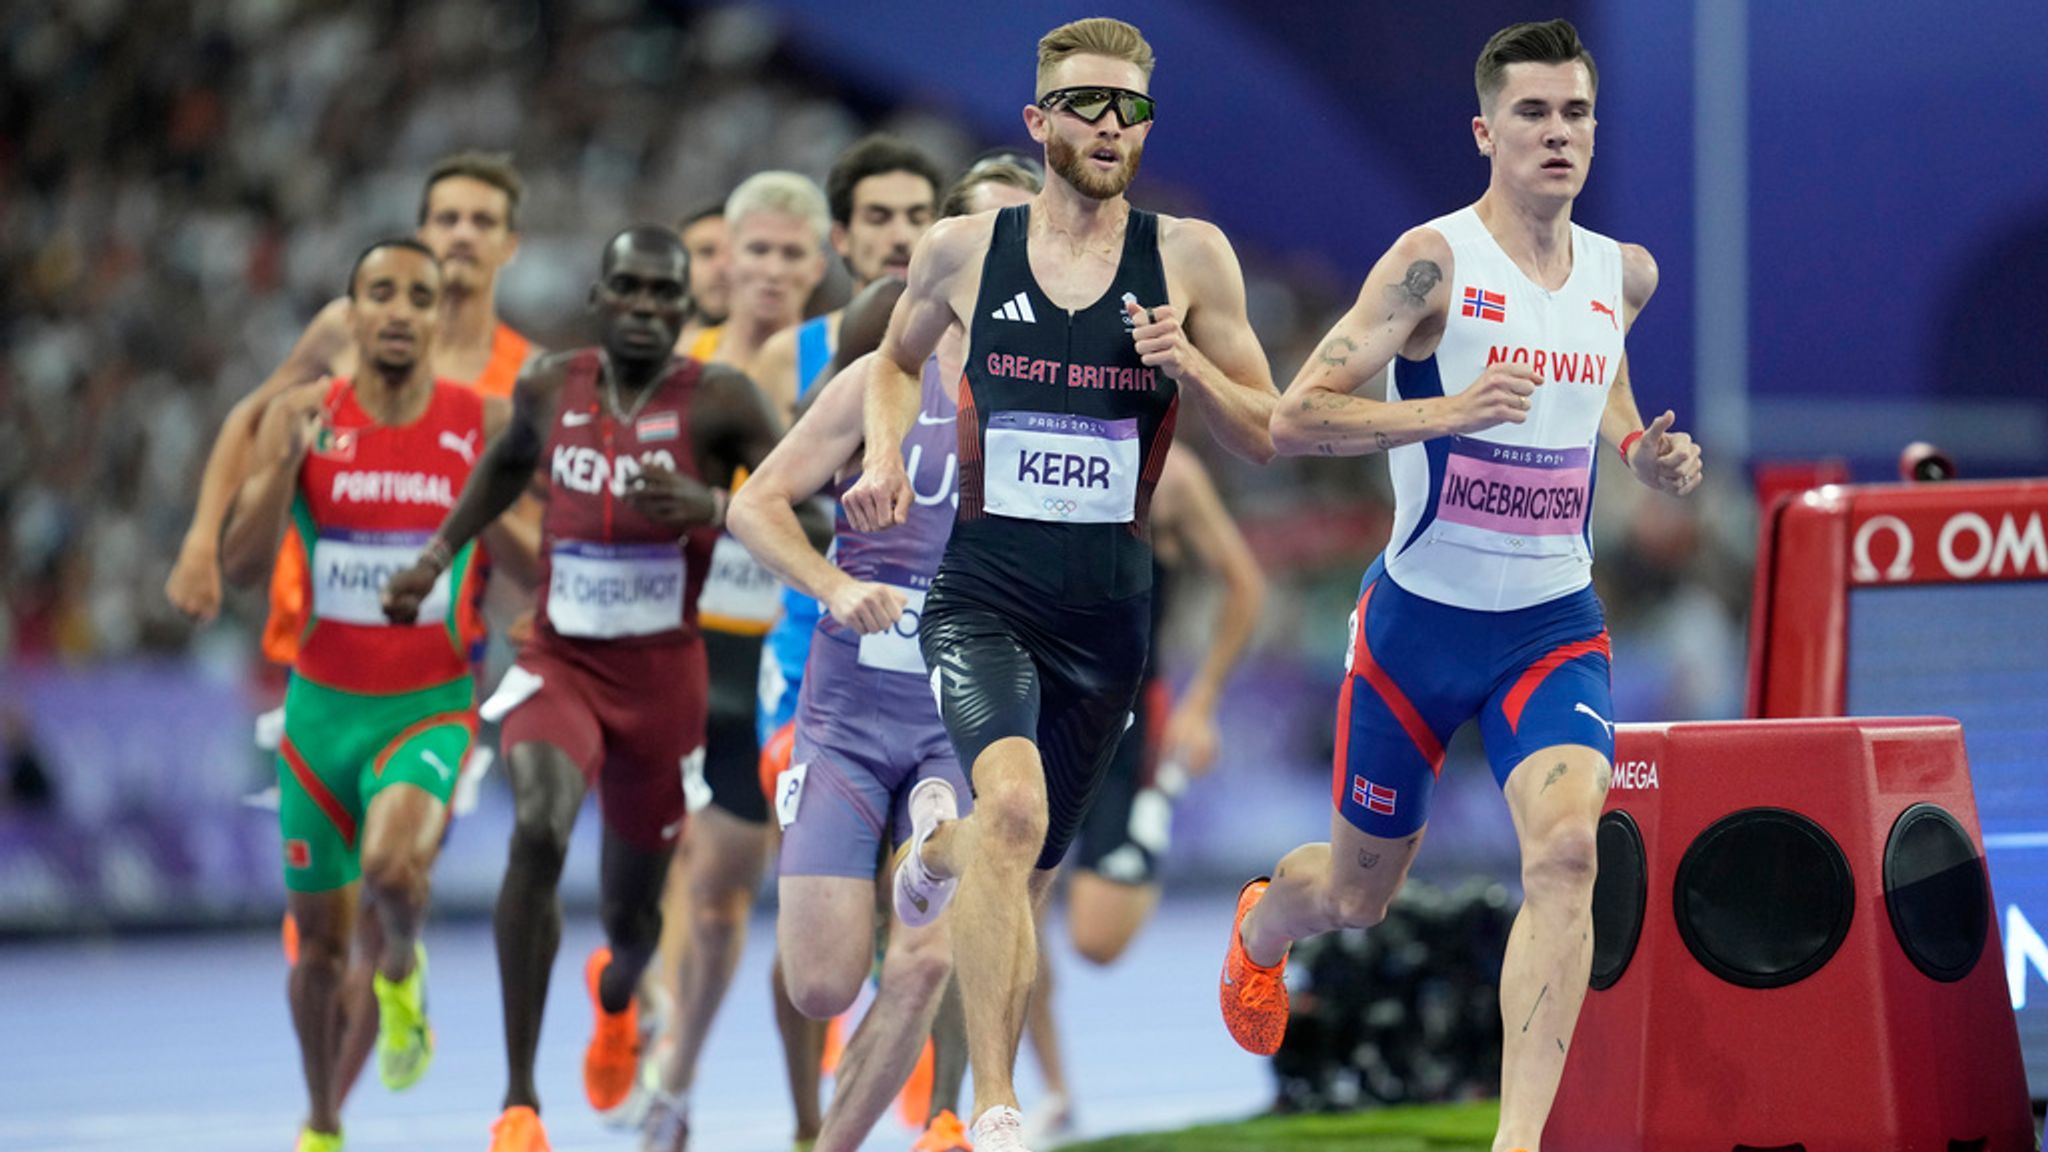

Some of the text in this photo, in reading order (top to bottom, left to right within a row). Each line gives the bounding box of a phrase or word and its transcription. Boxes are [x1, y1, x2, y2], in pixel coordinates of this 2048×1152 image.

[987, 352, 1156, 391] GREAT BRITAIN
[331, 470, 456, 508] PORTUGAL
[1018, 450, 1111, 489] KERR
[1445, 474, 1584, 520] INGEBRIGTSEN
[1611, 761, 1659, 790] MEGA
